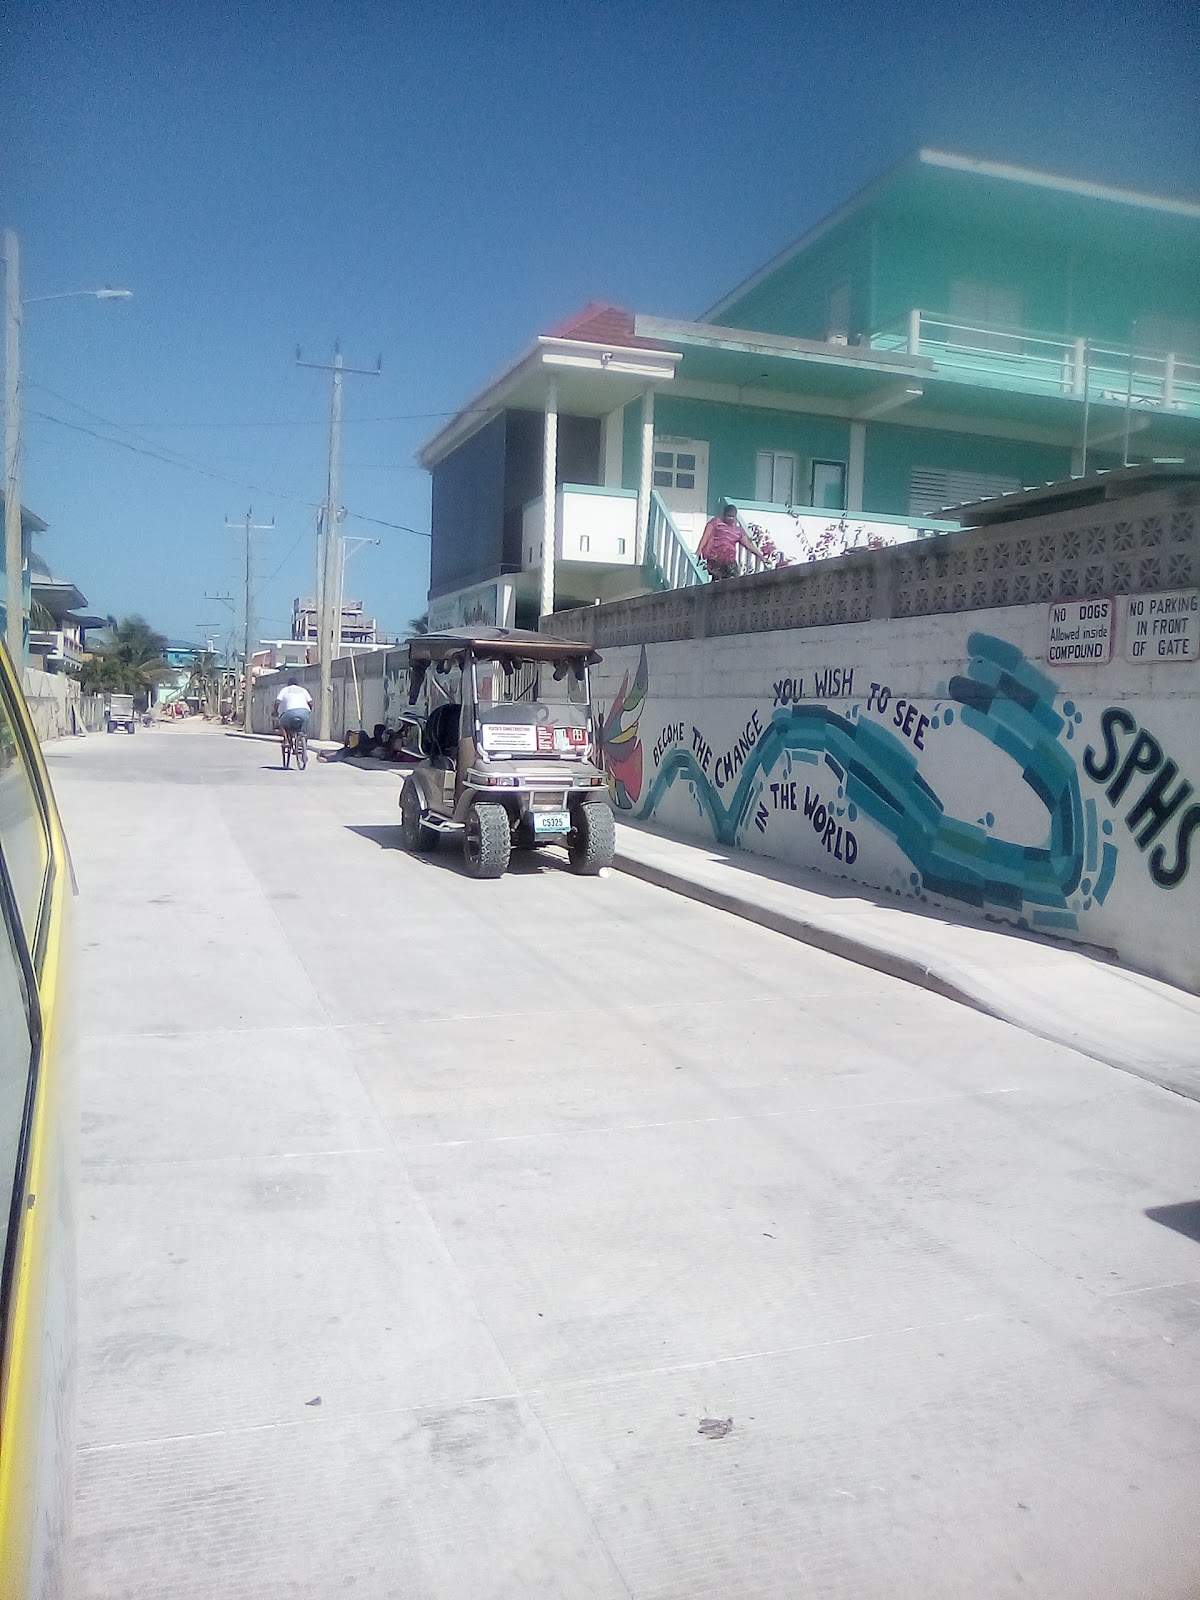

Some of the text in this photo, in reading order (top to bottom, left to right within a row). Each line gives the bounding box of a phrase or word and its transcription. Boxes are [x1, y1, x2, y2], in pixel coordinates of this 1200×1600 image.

[1053, 603, 1109, 623] NO DOGS
[1129, 595, 1199, 617] NO PARKING
[1050, 625, 1108, 642] Allowed inside
[1136, 617, 1190, 636] IN FRONT
[1049, 643, 1103, 661] COMPOUND
[1132, 638, 1190, 657] OF GATE
[652, 668, 930, 789] BECOME THE CHANGE YOU WISH TO SEE
[1083, 706, 1200, 890] SPHS
[755, 782, 858, 865] IN THE WORLD
